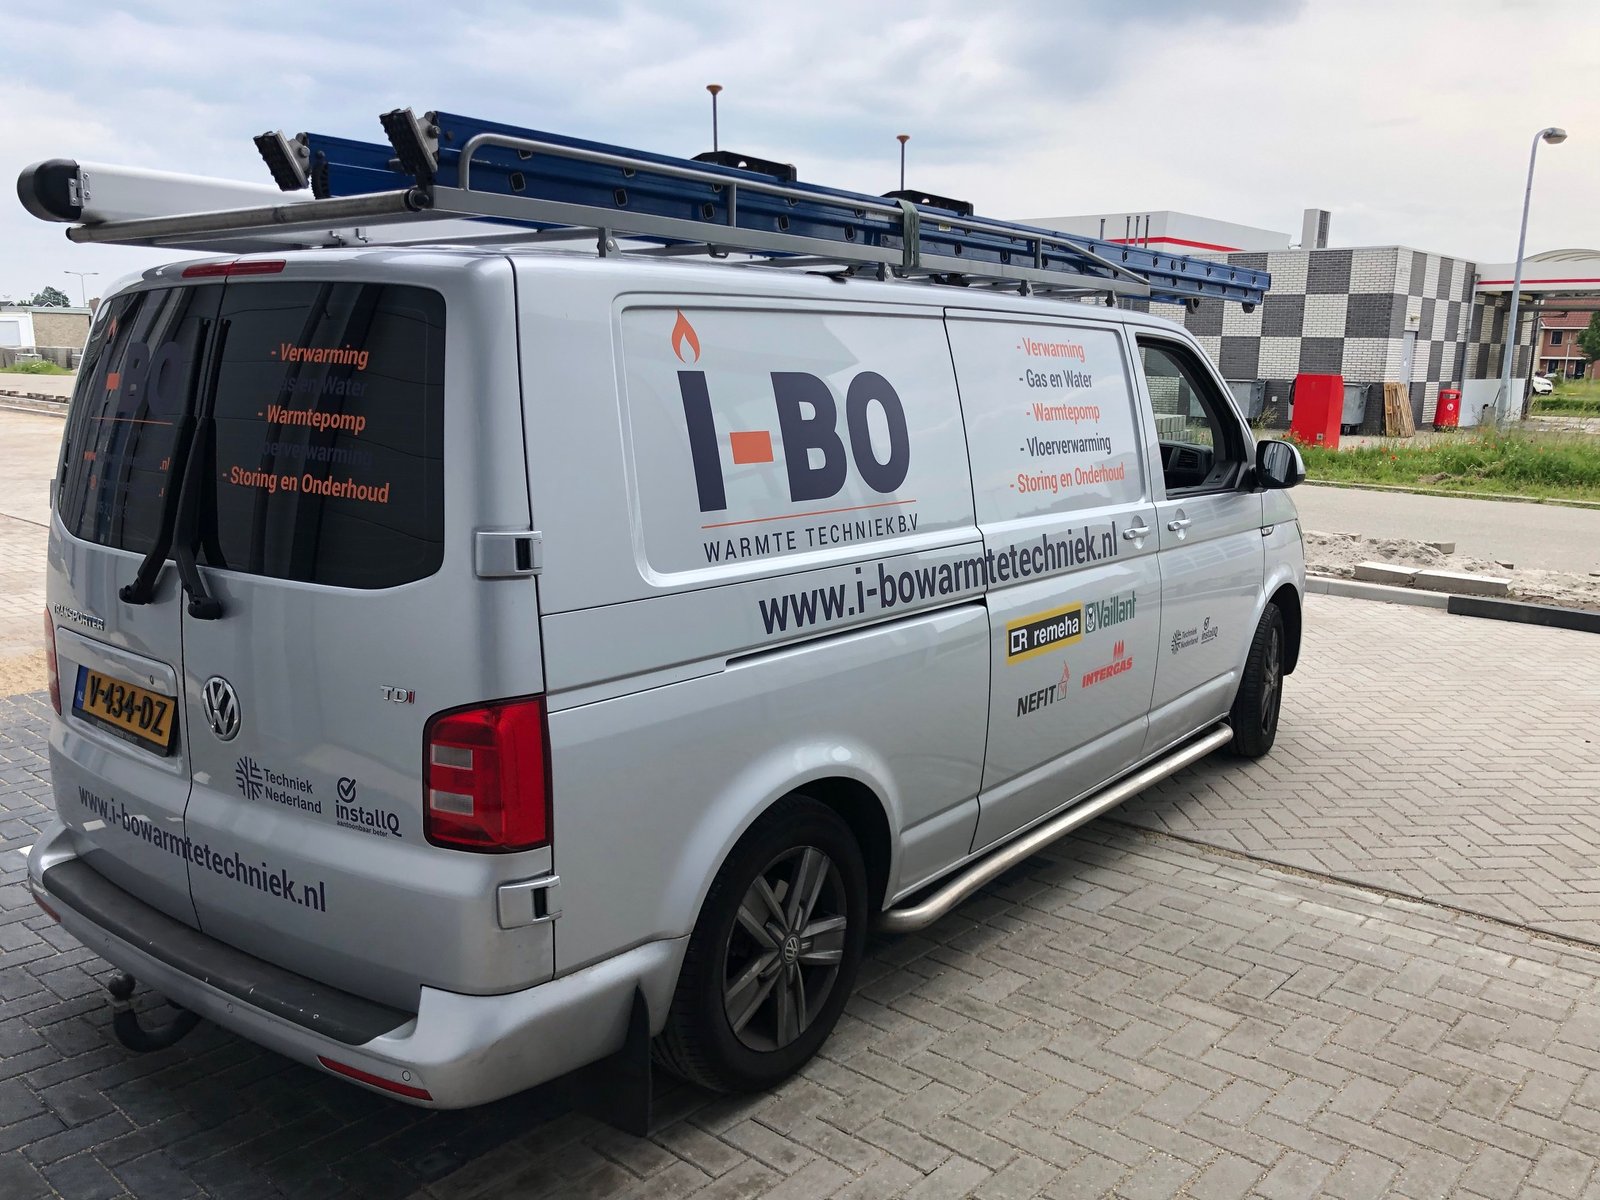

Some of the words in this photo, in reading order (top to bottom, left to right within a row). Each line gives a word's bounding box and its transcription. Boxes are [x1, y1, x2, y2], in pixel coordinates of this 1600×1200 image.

[281, 343, 370, 371] Verwarming
[1023, 337, 1086, 363] Verwarming
[1026, 368, 1047, 388] Gas
[1050, 373, 1063, 387] en
[1063, 370, 1092, 388] Water
[267, 404, 367, 435] Warmtepomp
[1033, 403, 1100, 424] Warmtepomp
[1026, 433, 1112, 457] Vloerverwarming
[230, 465, 277, 493] Storing
[280, 478, 298, 491] en
[301, 473, 390, 503] Onderhoud
[1018, 470, 1058, 493] Storing
[1060, 472, 1073, 488] en
[1074, 462, 1125, 485] Onderhoud
[704, 530, 797, 562] WARMTE
[805, 517, 896, 547] TECHNIEK
[759, 521, 1118, 635] www.i-bowarmtetechniek.nl
[54, 603, 105, 631] TRANSPORTER
[1096, 591, 1136, 629] Vaillant
[1034, 616, 1079, 646] remeha
[1082, 657, 1133, 688] INTERGAS
[89, 675, 168, 736] V-434-DZ
[380, 684, 416, 704] TDI
[1017, 683, 1057, 718] NEFIT
[263, 768, 314, 794] Techniek
[265, 787, 322, 814] Nederland
[335, 800, 402, 837] installQ
[78, 785, 326, 912] www.i-bowarmtetechniek.nl
